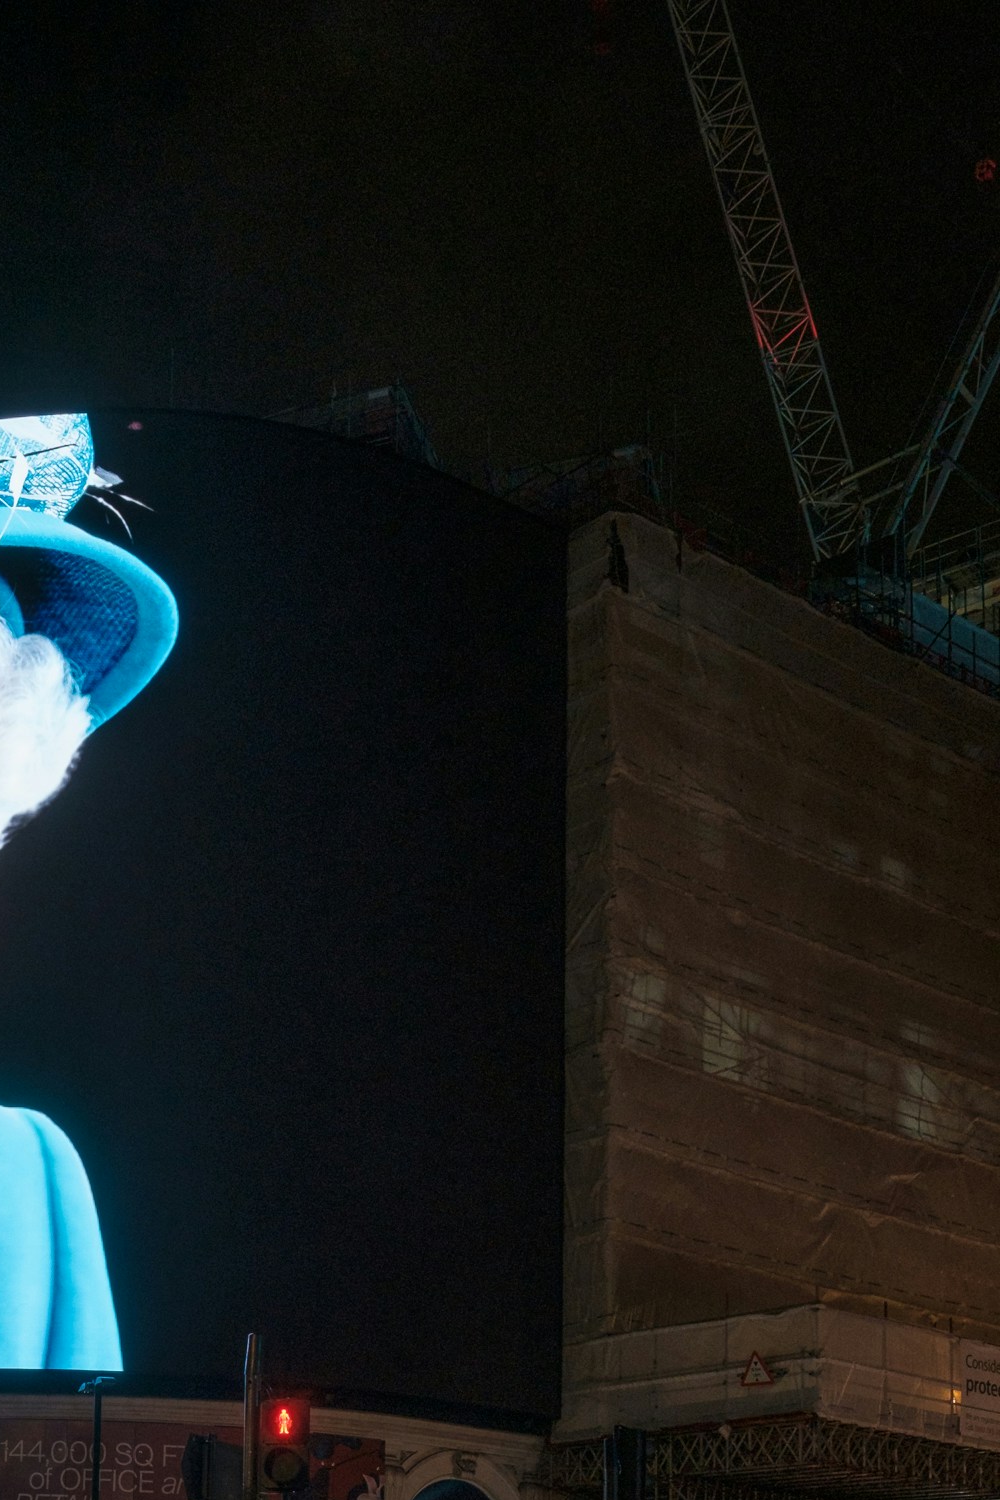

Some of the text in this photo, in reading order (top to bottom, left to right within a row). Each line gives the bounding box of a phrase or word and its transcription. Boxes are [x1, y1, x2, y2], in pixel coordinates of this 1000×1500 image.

[966, 1378, 1000, 1396] prote
[0, 1440, 186, 1467] 144,000 SQ F
[29, 1468, 52, 1490] of
[60, 1467, 154, 1494] OFFICE
